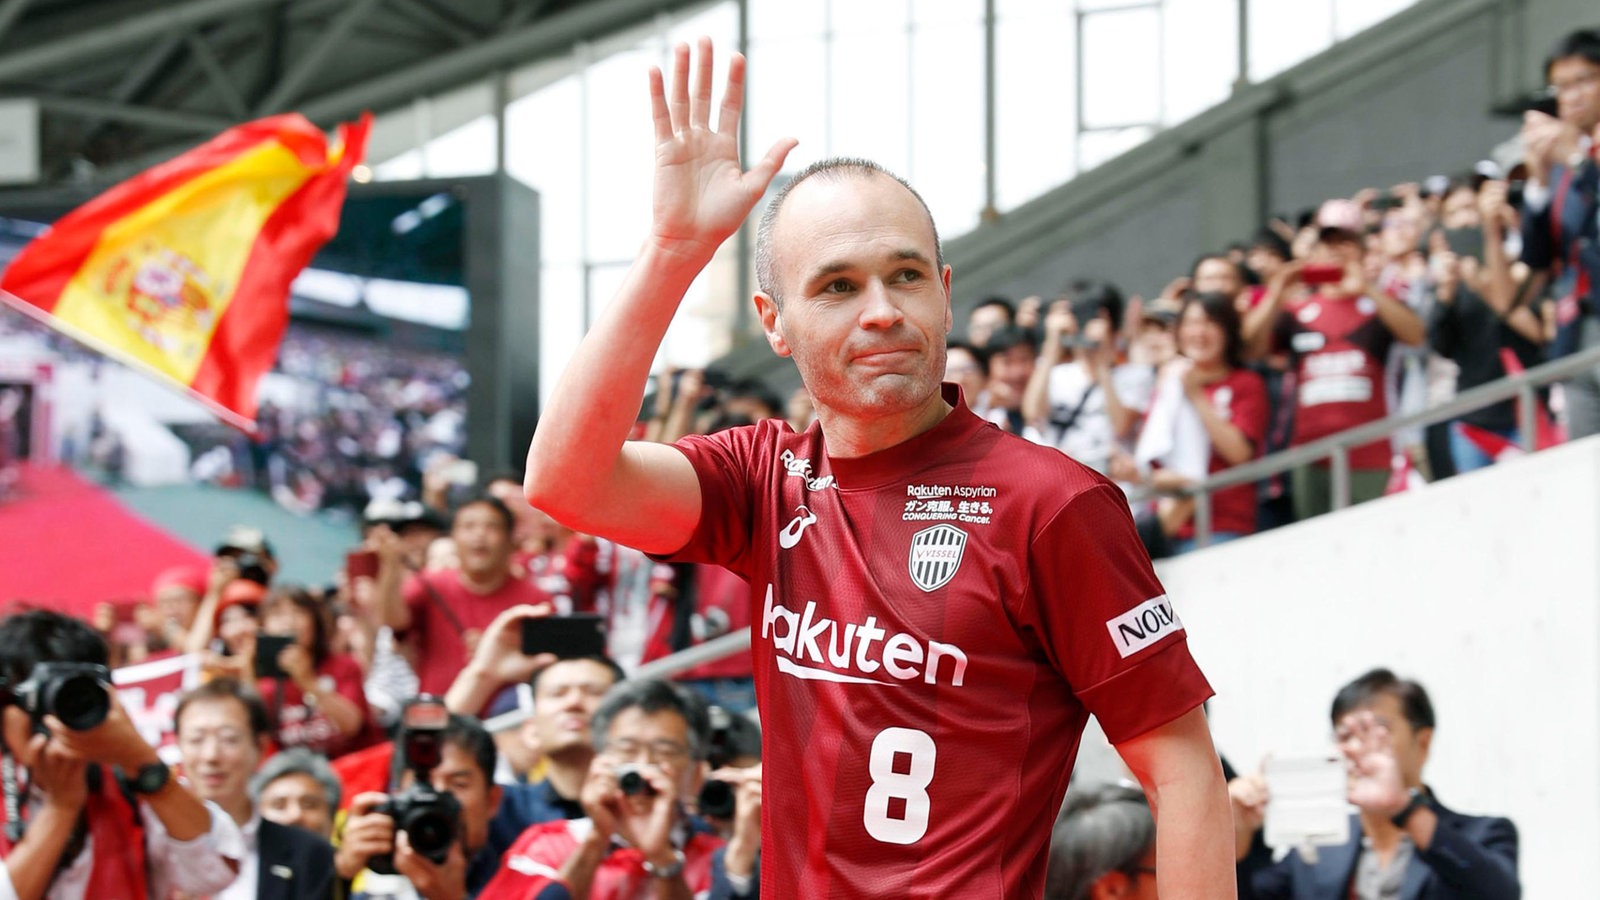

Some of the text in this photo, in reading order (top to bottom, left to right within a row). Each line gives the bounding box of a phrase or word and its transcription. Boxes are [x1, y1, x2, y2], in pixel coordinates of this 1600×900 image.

[907, 484, 997, 498] Rakuten Aspyrian
[902, 512, 957, 520] CONQUERING
[926, 550, 957, 559] VISSEL
[863, 726, 937, 845] 8
